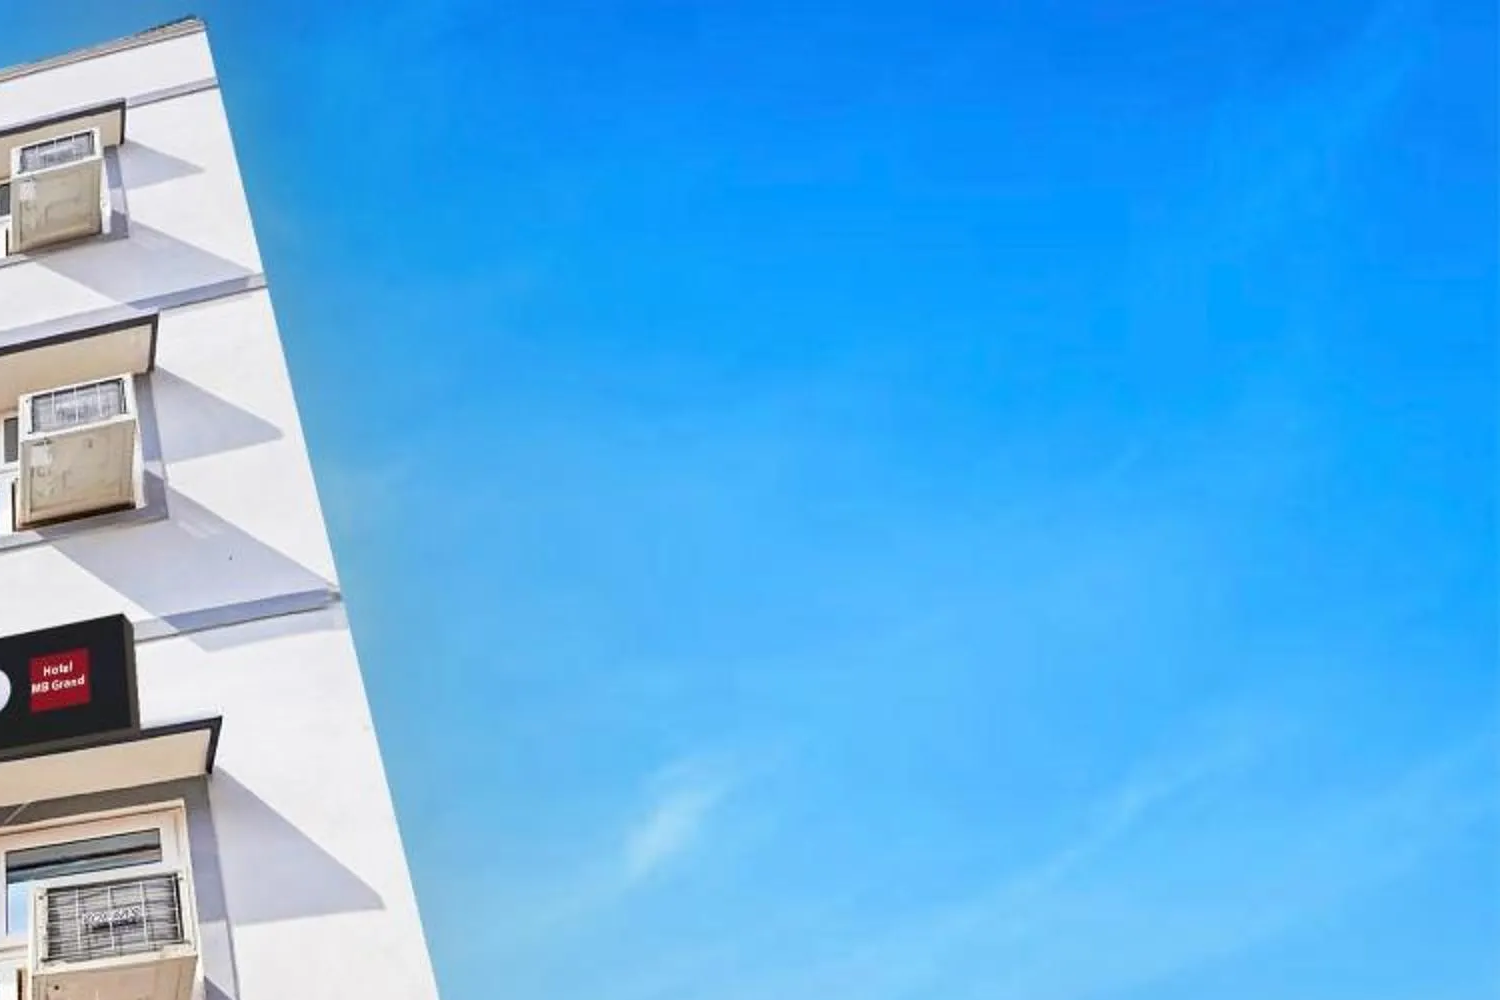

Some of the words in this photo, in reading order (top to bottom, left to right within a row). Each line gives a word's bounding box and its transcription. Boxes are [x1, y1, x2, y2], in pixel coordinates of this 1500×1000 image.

[43, 660, 73, 677] Hotel
[31, 681, 49, 695] MB
[51, 674, 85, 691] Grand
